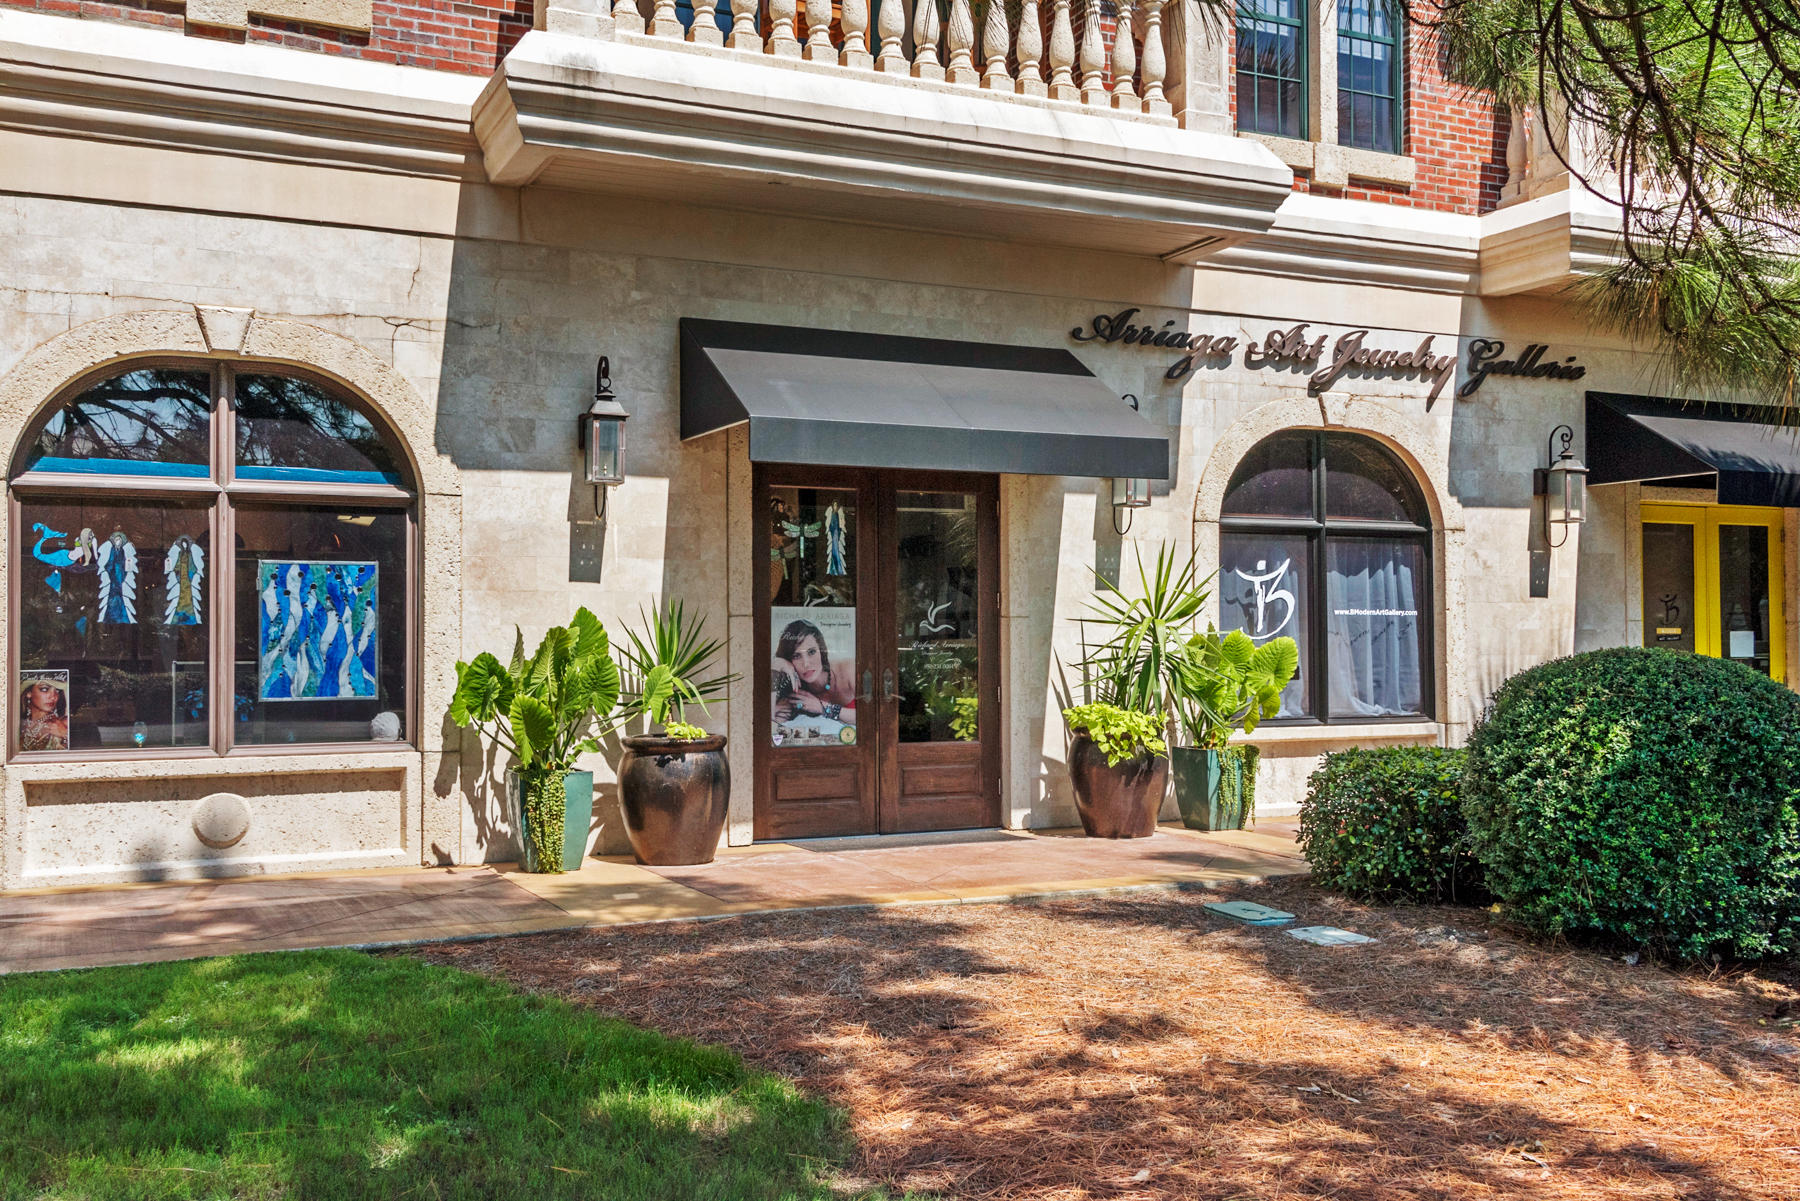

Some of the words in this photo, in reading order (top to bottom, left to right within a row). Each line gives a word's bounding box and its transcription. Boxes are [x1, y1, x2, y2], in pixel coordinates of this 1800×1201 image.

[1072, 308, 1239, 380] Arriaga
[1247, 324, 1329, 361] Art
[1311, 330, 1457, 405] Jewelry
[1333, 607, 1418, 617] www.BModernArtGallery.com
